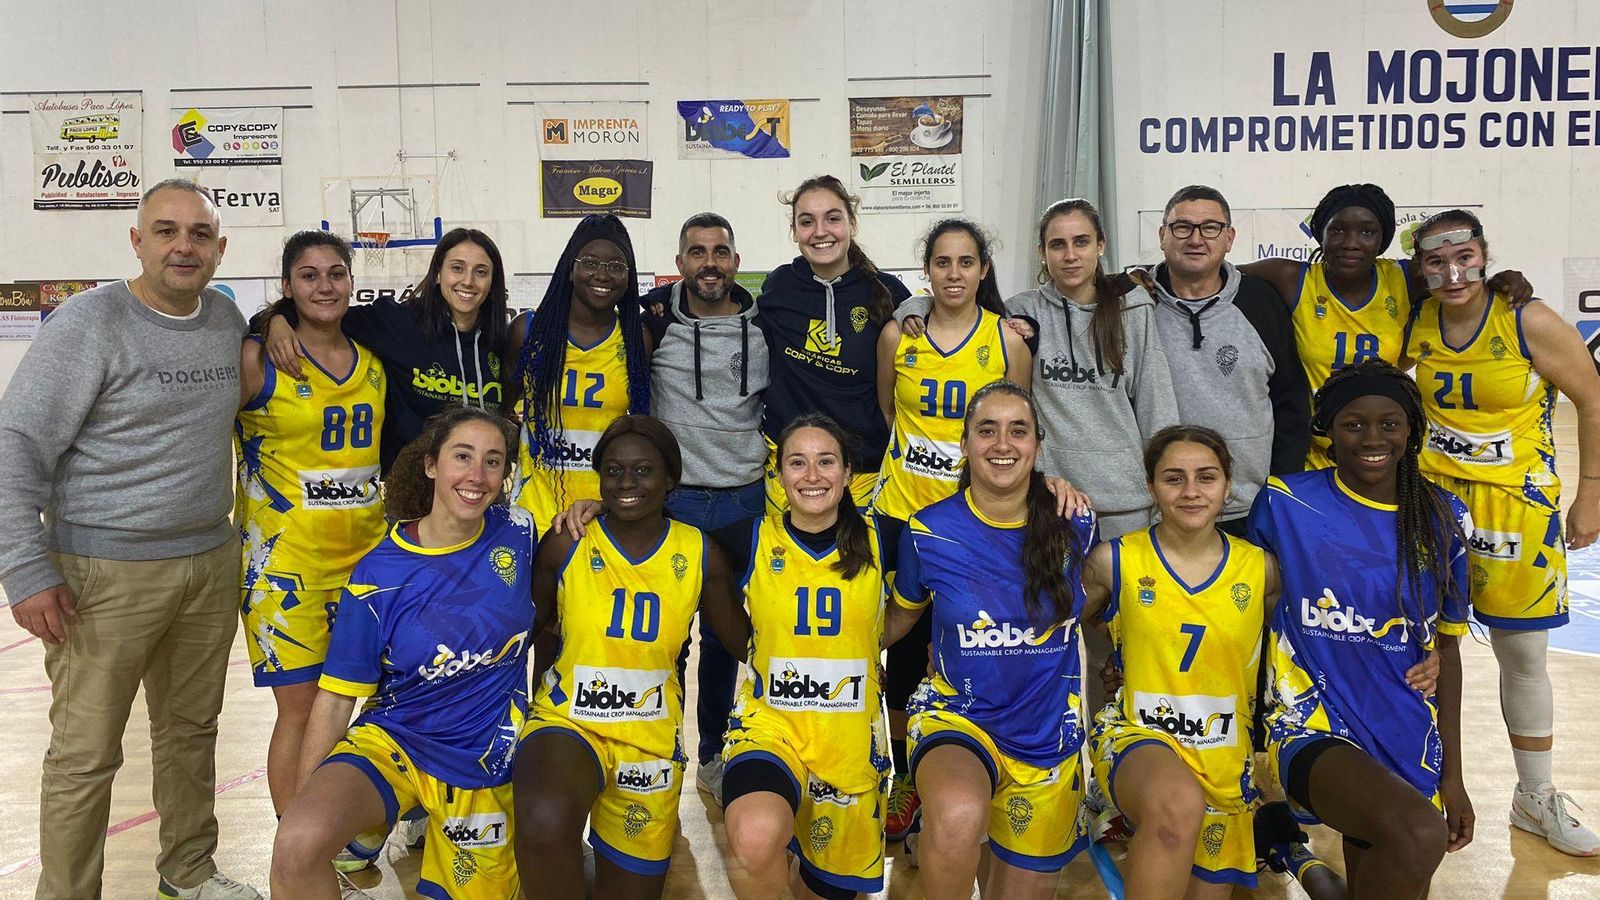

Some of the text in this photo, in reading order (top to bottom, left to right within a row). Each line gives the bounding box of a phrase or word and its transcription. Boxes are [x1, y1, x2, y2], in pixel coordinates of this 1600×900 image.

[1272, 46, 1600, 106] LA MOJONE
[34, 97, 133, 112] Autobuses Paco López
[758, 104, 781, 112] PLAY?
[208, 124, 278, 132] COPY&COPY
[573, 118, 638, 129] IMPRENTA
[1139, 109, 1600, 154] COMPROMETIDOS CON E
[41, 159, 140, 189] Publiser
[891, 162, 956, 177] El Plantel
[212, 188, 280, 207] Ferva
[578, 185, 618, 198] Magar
[1395, 212, 1417, 227] cola
[1331, 331, 1379, 370] 18
[784, 346, 860, 376] COPY & COPY
[158, 366, 238, 384] DOCKERS
[562, 368, 605, 408] 12
[1433, 371, 1479, 410] 21
[920, 378, 967, 419] 30
[320, 403, 374, 452] 88
[605, 588, 660, 643] 10
[793, 586, 842, 636] 19
[1302, 627, 1346, 642] SUSTAINABLE
[1024, 645, 1069, 655] MANAGEMENT
[1179, 622, 1207, 673] 7
[770, 699, 803, 707] SUSTAINABLE
[573, 708, 610, 718] SUSTAINABLE
[625, 710, 661, 718] MANAGEMENT
